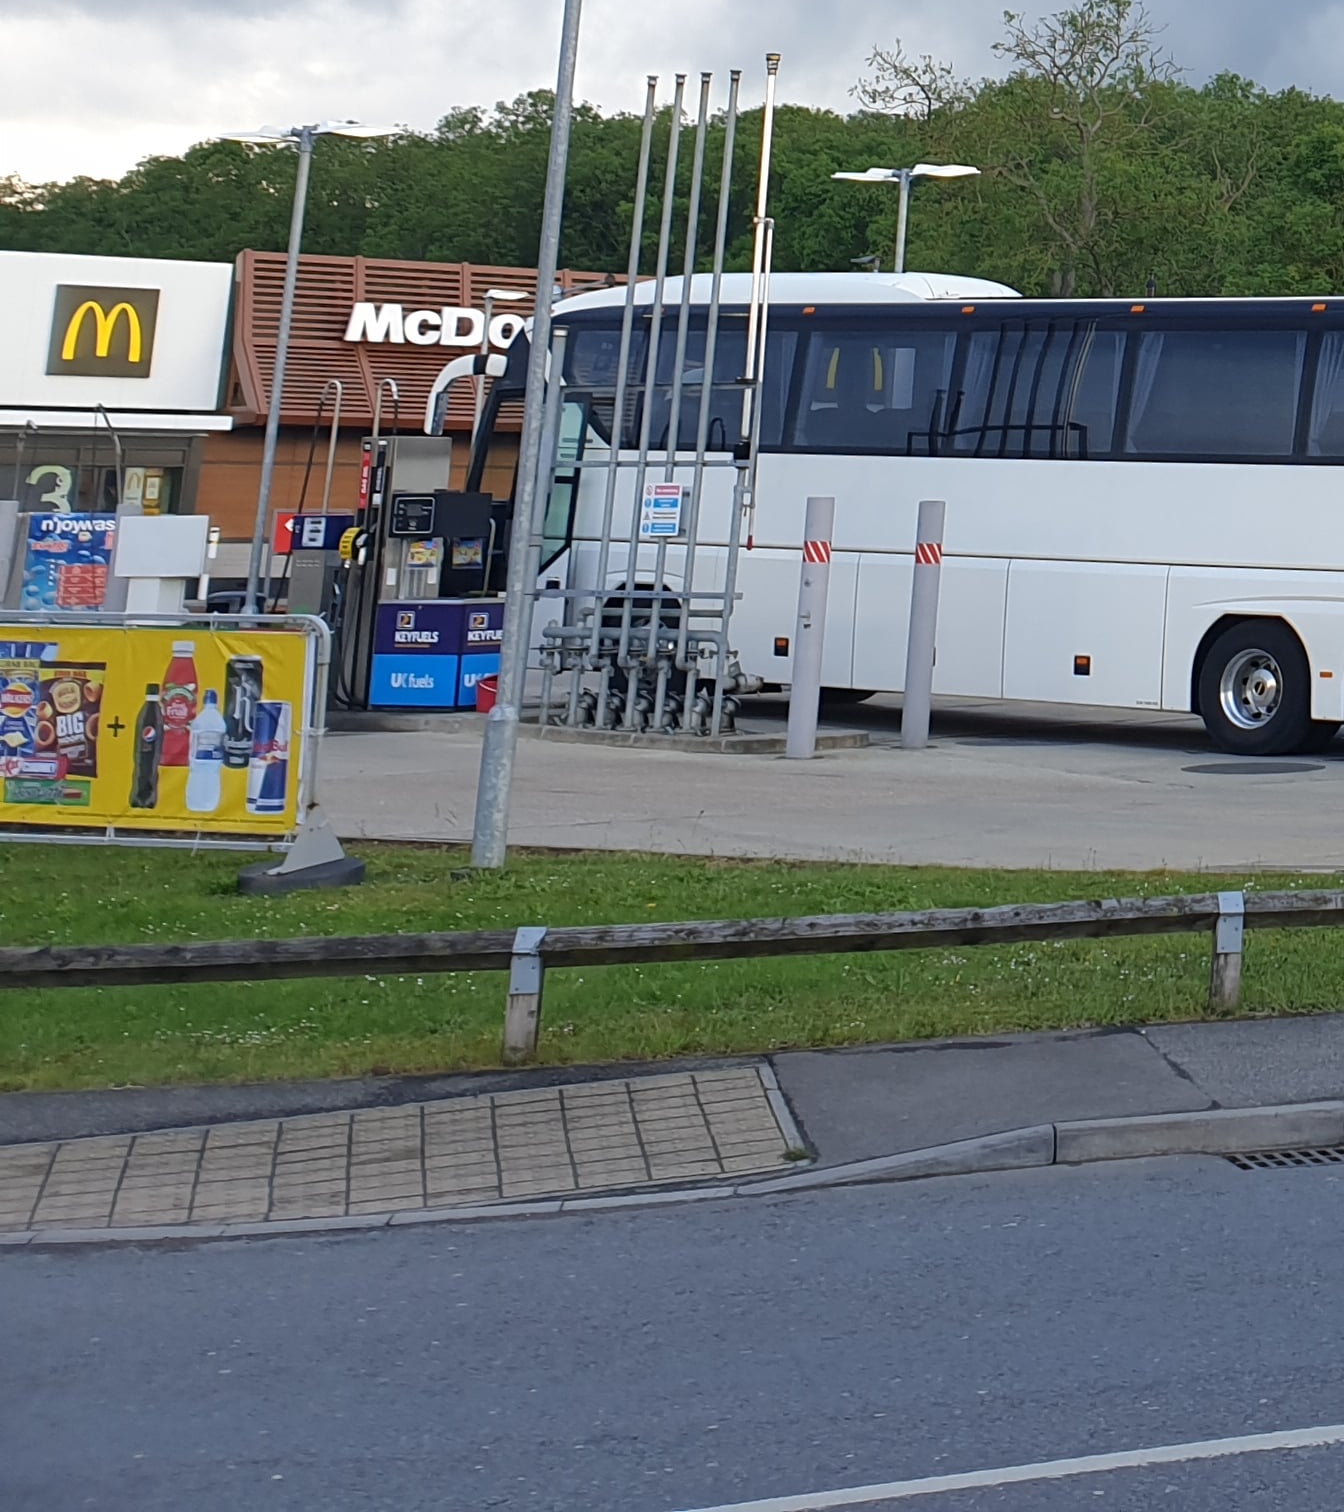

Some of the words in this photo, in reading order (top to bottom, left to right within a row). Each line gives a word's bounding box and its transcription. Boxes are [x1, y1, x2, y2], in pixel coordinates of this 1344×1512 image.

[394, 631, 439, 643] KEYFUELS
[408, 673, 434, 688] fuels
[55, 711, 85, 738] BIG
